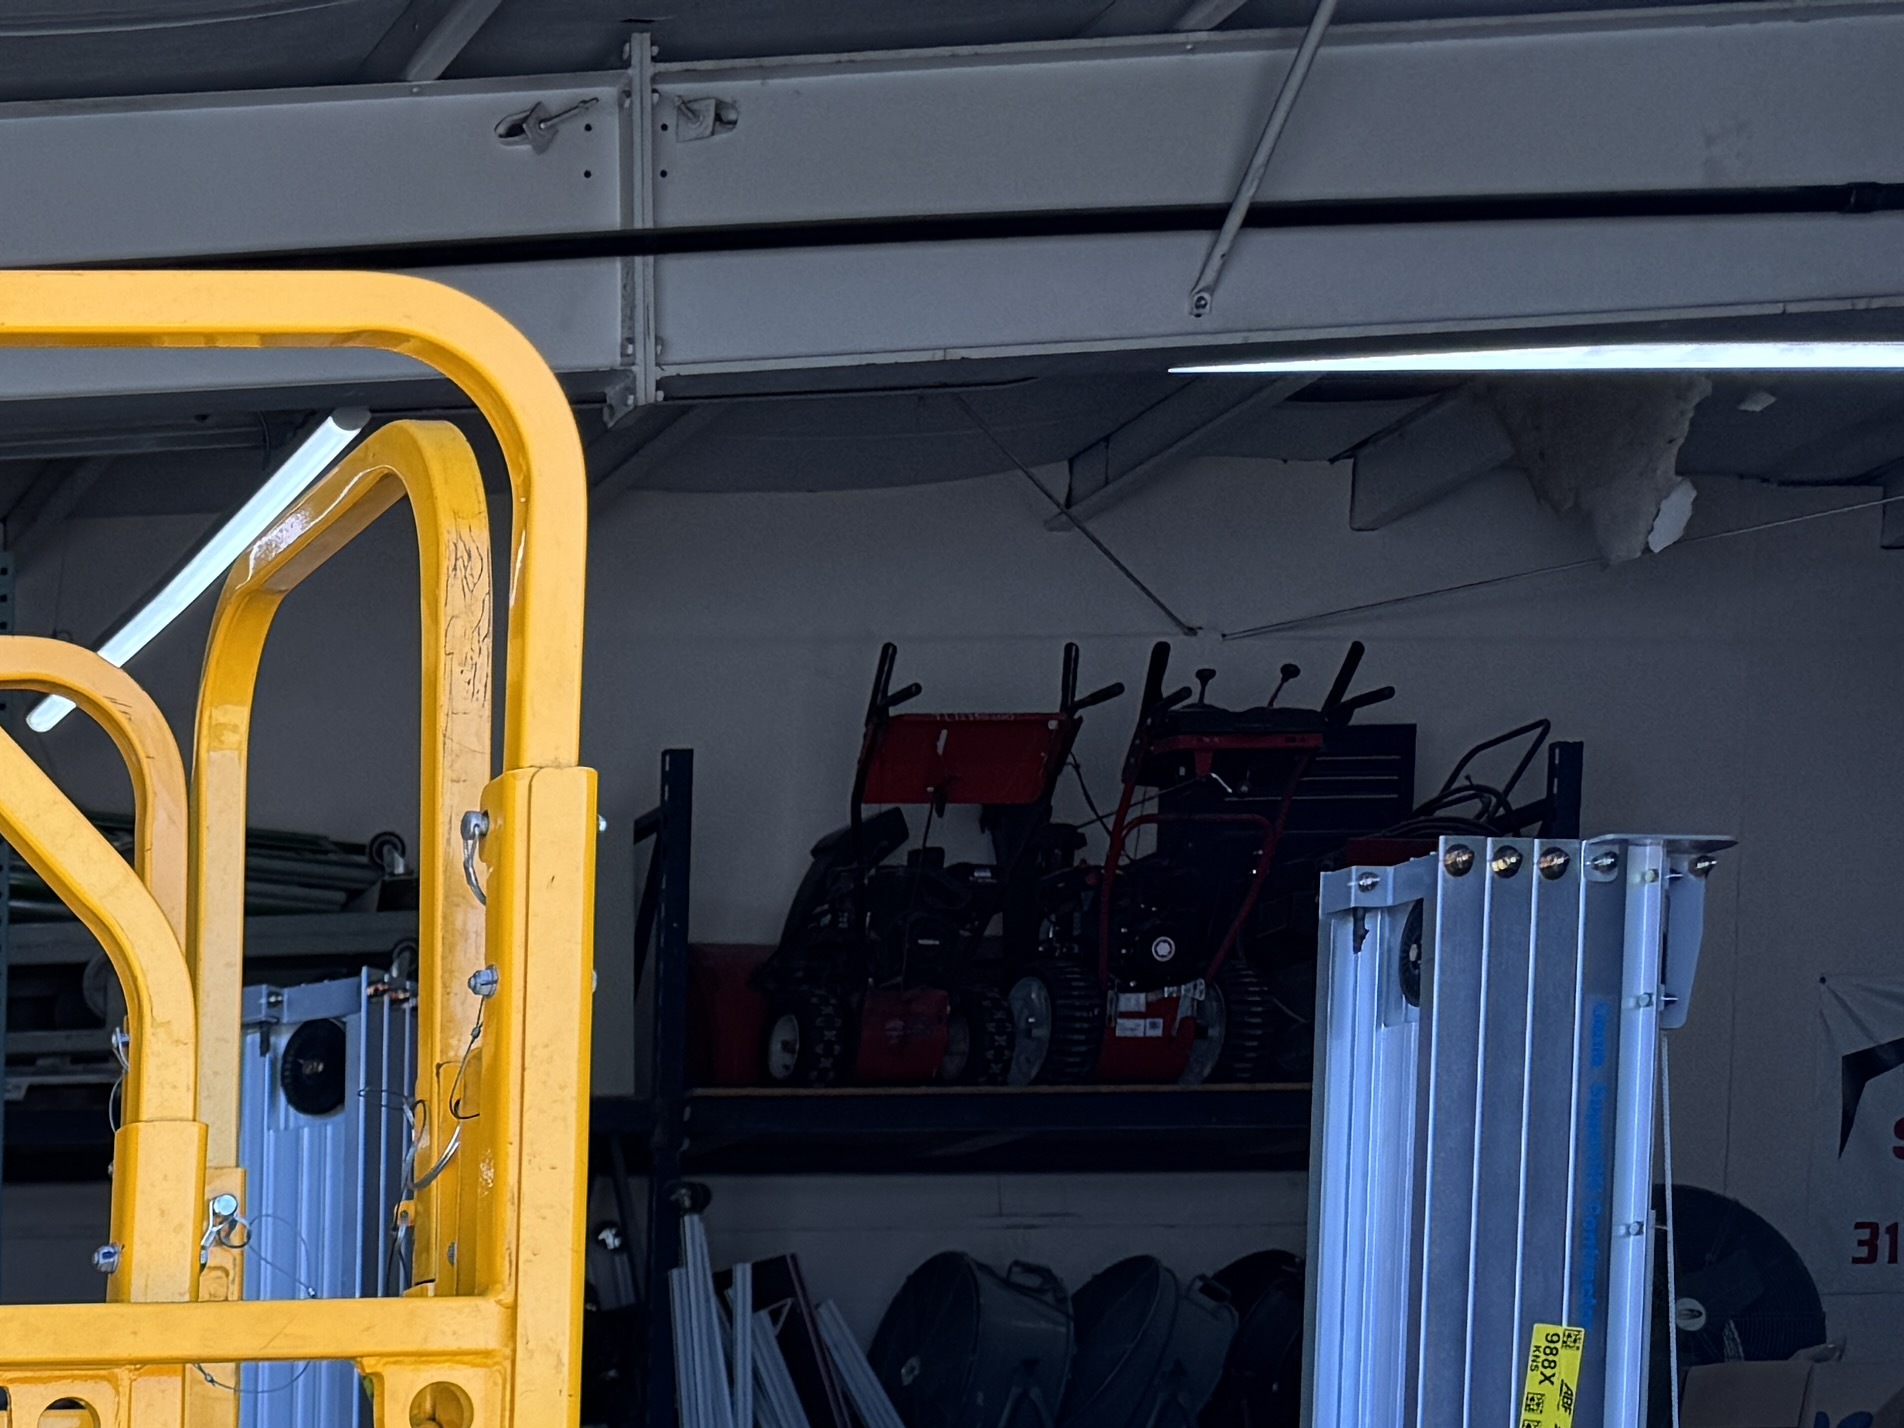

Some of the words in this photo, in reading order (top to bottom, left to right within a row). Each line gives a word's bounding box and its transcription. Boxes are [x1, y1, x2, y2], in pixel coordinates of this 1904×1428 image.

[1530, 1344, 1542, 1373] KNS
[1538, 1333, 1561, 1386] 988X
[1558, 1381, 1575, 1418] ABF
